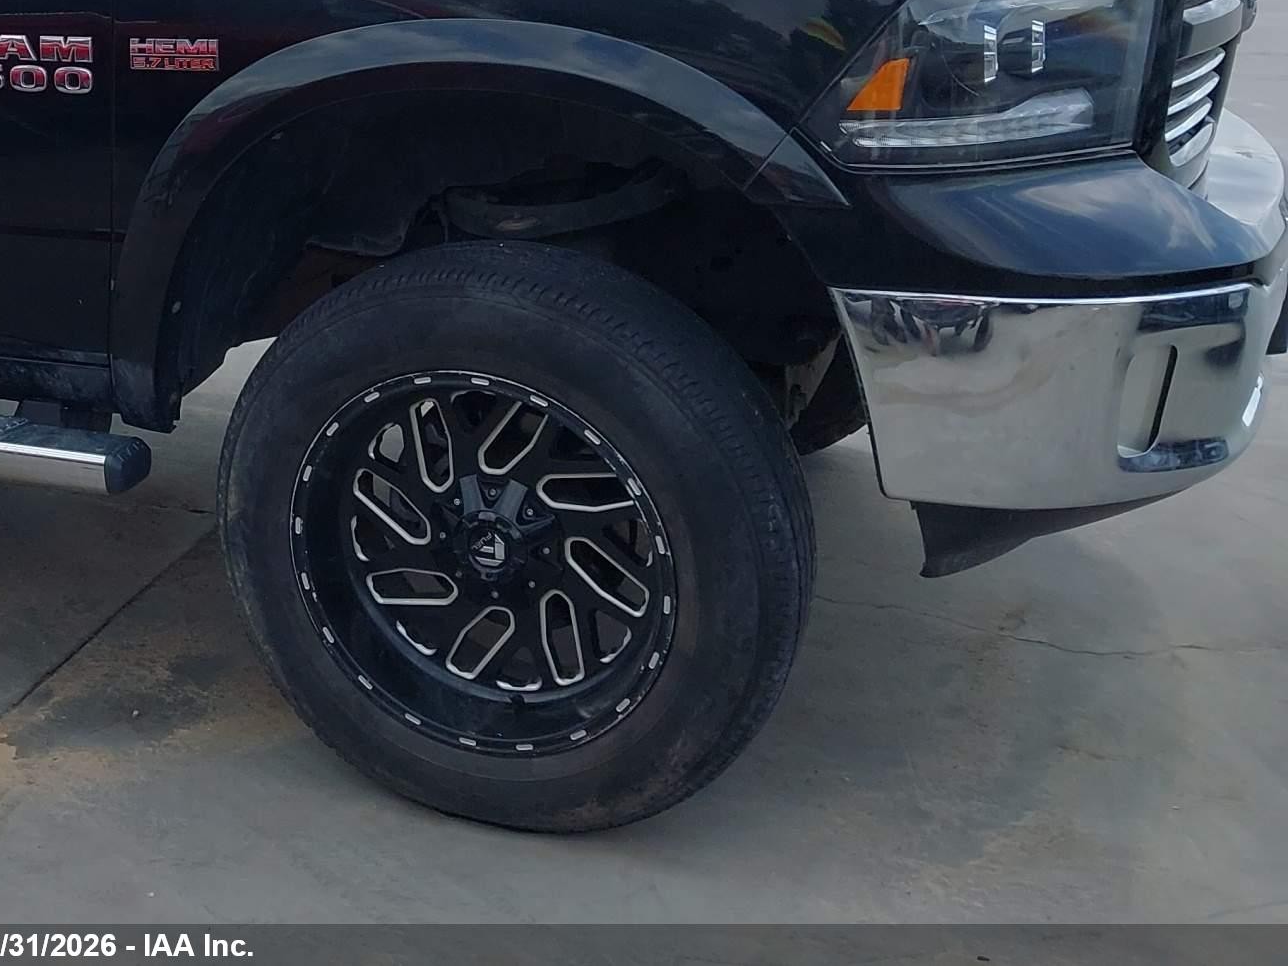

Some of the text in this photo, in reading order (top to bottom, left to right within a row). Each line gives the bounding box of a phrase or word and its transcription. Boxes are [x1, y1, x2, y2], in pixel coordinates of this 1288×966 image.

[129, 38, 219, 55] HEMI
[132, 56, 215, 70] 5.7 LITER
